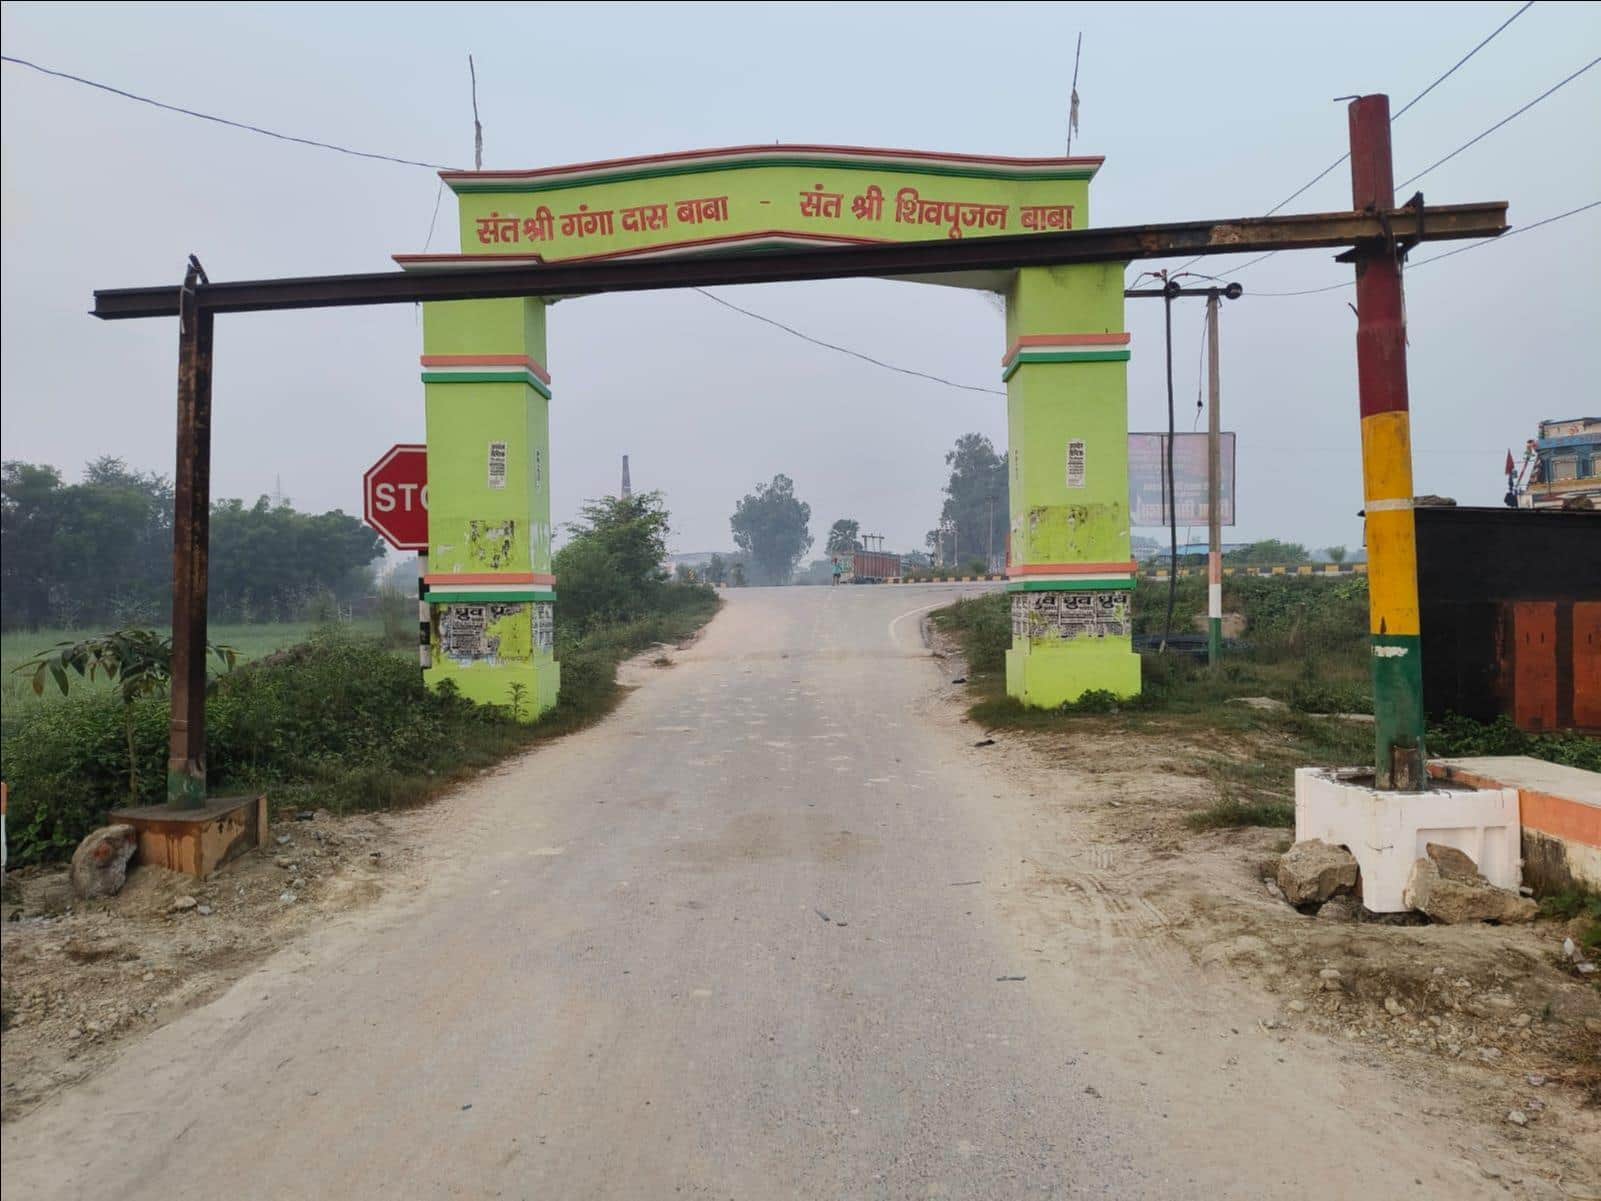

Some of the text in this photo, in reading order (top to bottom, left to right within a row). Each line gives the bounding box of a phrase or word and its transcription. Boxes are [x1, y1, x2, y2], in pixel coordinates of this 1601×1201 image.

[476, 212, 520, 244] संत
[523, 206, 554, 242] श्री
[559, 204, 614, 238] गंगा
[620, 203, 669, 232] दास
[675, 196, 729, 224] बाबा
[800, 183, 844, 218] संत
[851, 185, 885, 221] श्री
[895, 187, 1009, 240] शिवपूजन
[1020, 205, 1075, 231] बाबा
